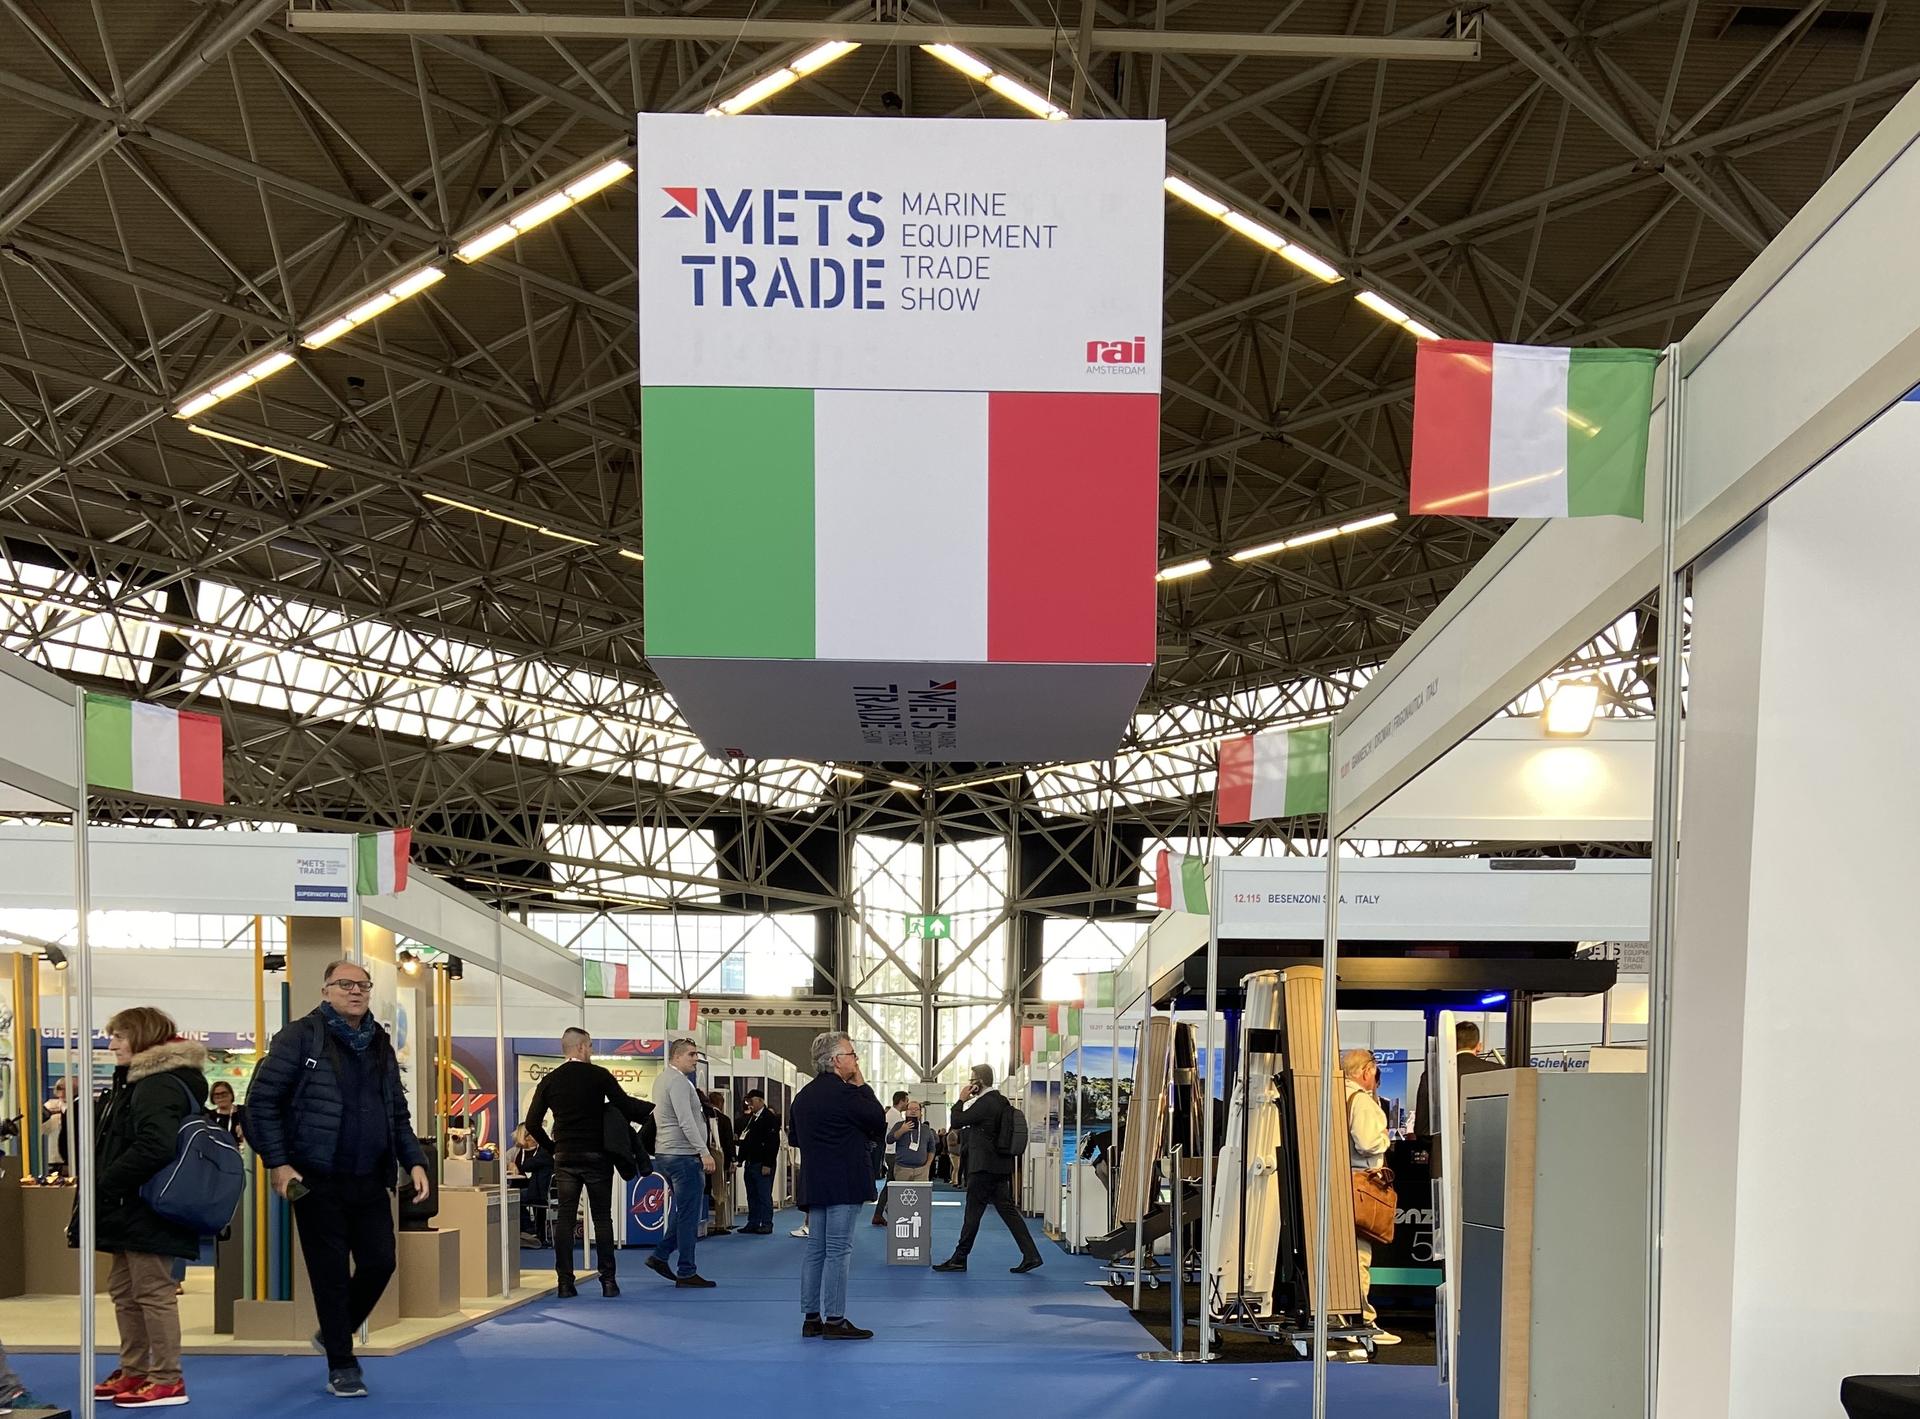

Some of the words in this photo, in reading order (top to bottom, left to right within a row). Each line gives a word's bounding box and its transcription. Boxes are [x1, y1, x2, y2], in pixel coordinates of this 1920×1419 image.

[902, 192, 1008, 218] MARINE
[704, 188, 886, 248] METS
[901, 224, 1059, 250] EQUIPMENT
[901, 256, 991, 281] TRADE
[681, 254, 886, 311] TRADE
[901, 287, 981, 312] SHOW
[1087, 336, 1146, 364] rai
[1086, 366, 1146, 375] AMSTERDAM
[1234, 895, 1261, 903] 12.115
[1268, 895, 1321, 904] BESENZONI
[1355, 895, 1380, 904] ITALY
[1530, 1057, 1589, 1068] Schenker
[897, 1246, 920, 1257] rai
